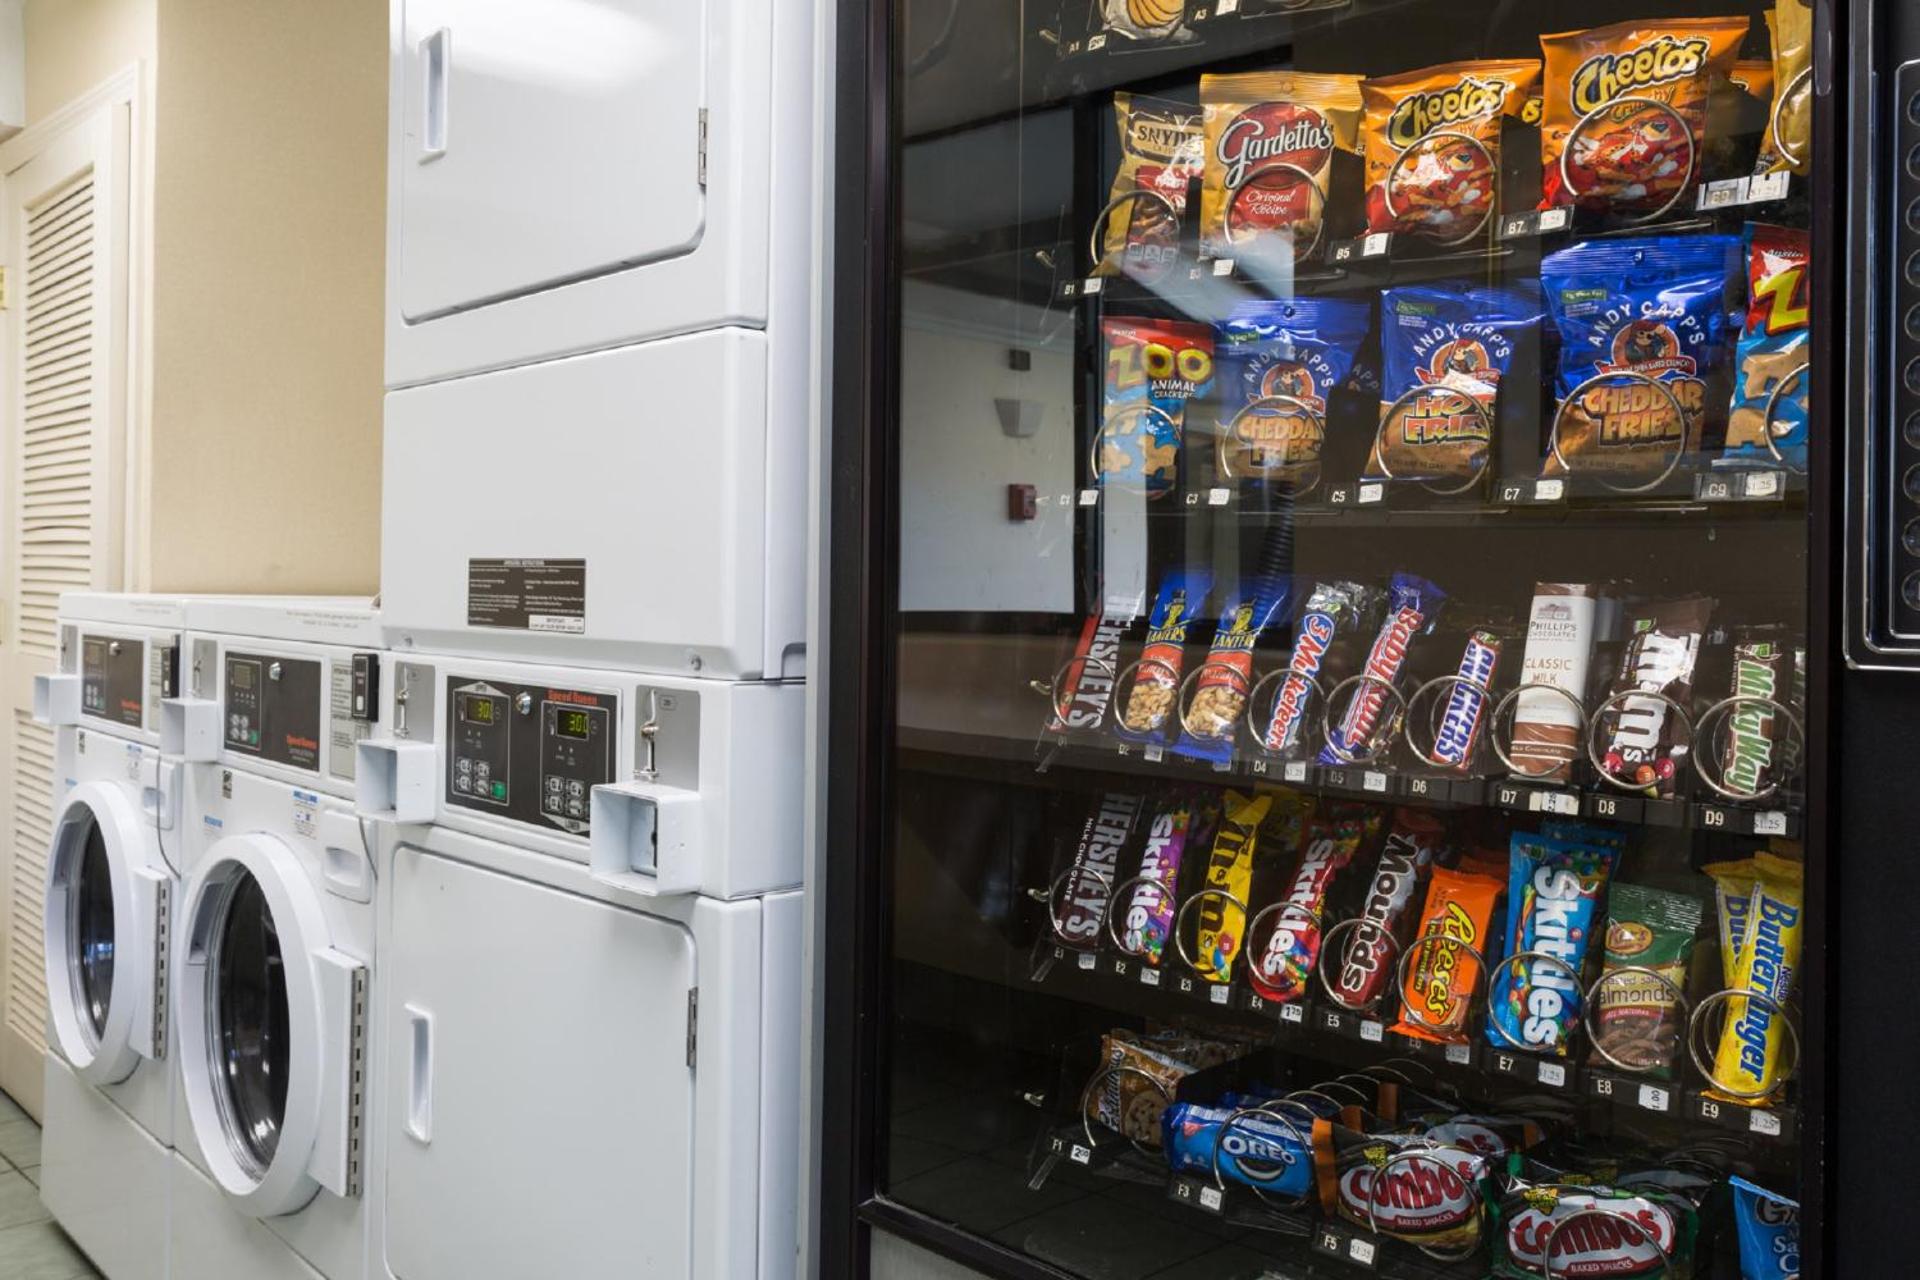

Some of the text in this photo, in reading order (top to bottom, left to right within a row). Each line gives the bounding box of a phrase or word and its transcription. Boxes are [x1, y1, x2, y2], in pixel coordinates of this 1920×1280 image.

[1572, 36, 1708, 118] Cheetos
[1388, 80, 1508, 149] Cheetos
[1219, 118, 1334, 189] Gardetto's
[1246, 189, 1297, 203] Original
[1250, 201, 1289, 218] Recipe
[1508, 220, 1525, 235] B7
[1336, 247, 1350, 260] B5
[1588, 301, 1706, 347] ANDY CAPP'S
[1413, 323, 1511, 358] ANDY CAPP'S
[1108, 342, 1212, 388] ZOO
[1244, 345, 1335, 388] ANDY CAPP'S
[1151, 380, 1196, 392] ANIMAL
[1332, 491, 1346, 503] C5
[1504, 487, 1520, 500] C7
[1708, 483, 1727, 496] C9
[1186, 493, 1199, 505] C3
[1308, 615, 1331, 641] 3
[1530, 621, 1577, 632] PHILLIPS
[1369, 606, 1425, 682] Baby
[1067, 604, 1133, 729] ERSHEY'S
[1525, 657, 1573, 671] CLASSIC
[1531, 671, 1557, 685] MILK
[1434, 638, 1498, 763] SNICKERS
[1729, 659, 1776, 737] Miky
[1254, 759, 1267, 774] D4
[1330, 770, 1344, 785] D5
[1412, 779, 1427, 793] D6
[1501, 789, 1517, 804] D7
[1598, 799, 1616, 815] D8
[1705, 810, 1725, 827] D9
[1066, 793, 1139, 938] HERSHEY'S
[1125, 813, 1174, 953] Skittles
[1263, 838, 1334, 976] Skittles
[1340, 832, 1421, 994] Mounds
[1424, 900, 1478, 1020] Reese's
[1522, 864, 1582, 1047] Skittles
[1115, 960, 1126, 974] E2
[1181, 978, 1192, 991] E3
[1600, 983, 1676, 1005] almonds
[1251, 995, 1263, 1010] E4
[1328, 1014, 1340, 1028] E5
[1618, 1008, 1651, 1018] NATURAL
[1500, 1055, 1514, 1071] E7
[1597, 1079, 1612, 1095] E8
[1701, 1101, 1720, 1119] E9
[1053, 1139, 1063, 1151] F1
[1223, 1135, 1297, 1165] OREO
[1178, 1183, 1190, 1197] F3
[1350, 1156, 1475, 1210] Combos
[1397, 1212, 1455, 1226] BAKED SNACKS
[1514, 1203, 1663, 1257] Combos
[1324, 1233, 1338, 1250] F5
[1570, 1258, 1634, 1273] BAKED SNACKS
